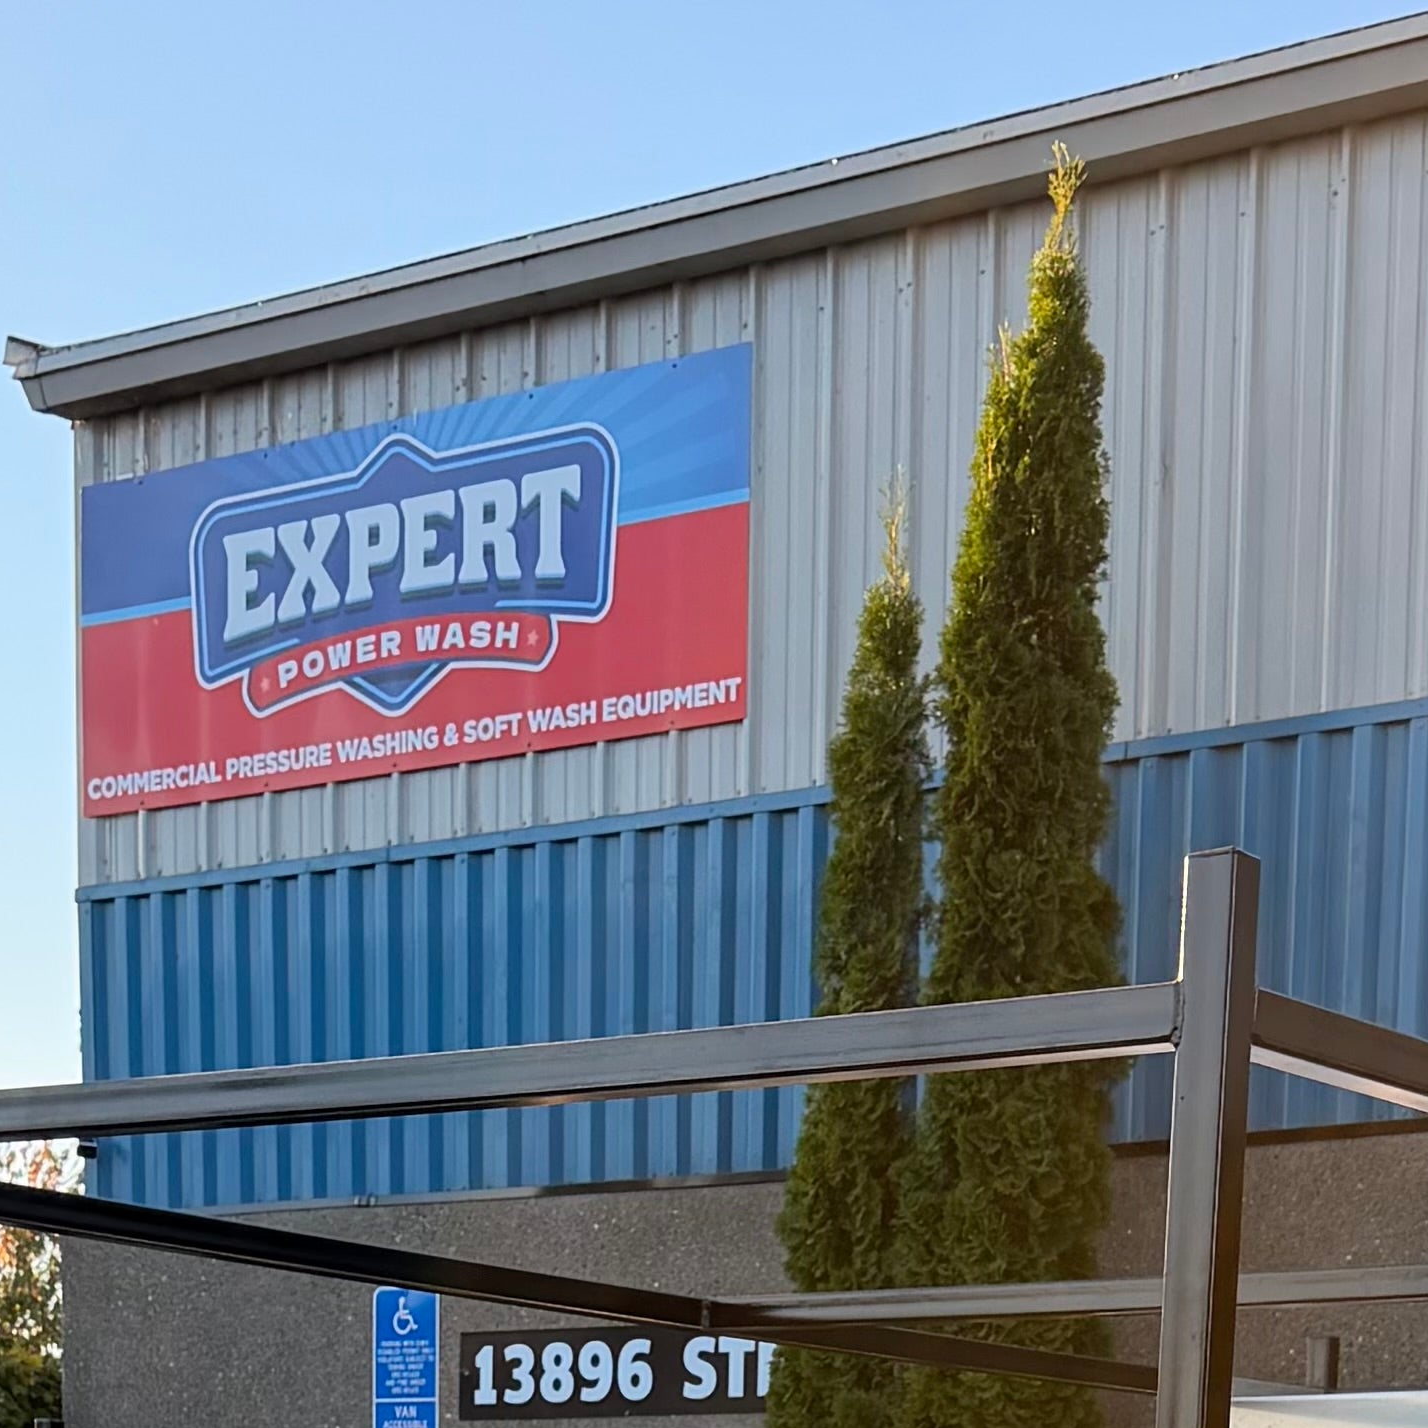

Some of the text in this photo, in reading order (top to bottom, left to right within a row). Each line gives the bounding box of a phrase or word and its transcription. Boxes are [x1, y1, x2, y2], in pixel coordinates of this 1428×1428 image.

[223, 464, 581, 646] EXPERT
[277, 621, 519, 688] POWER WASH
[87, 676, 742, 800] COMMERCIAL PRESSURE WASHING & SOFT WASH EQUIPMENT
[473, 1338, 654, 1406] 13896
[394, 1405, 417, 1419] VAN
